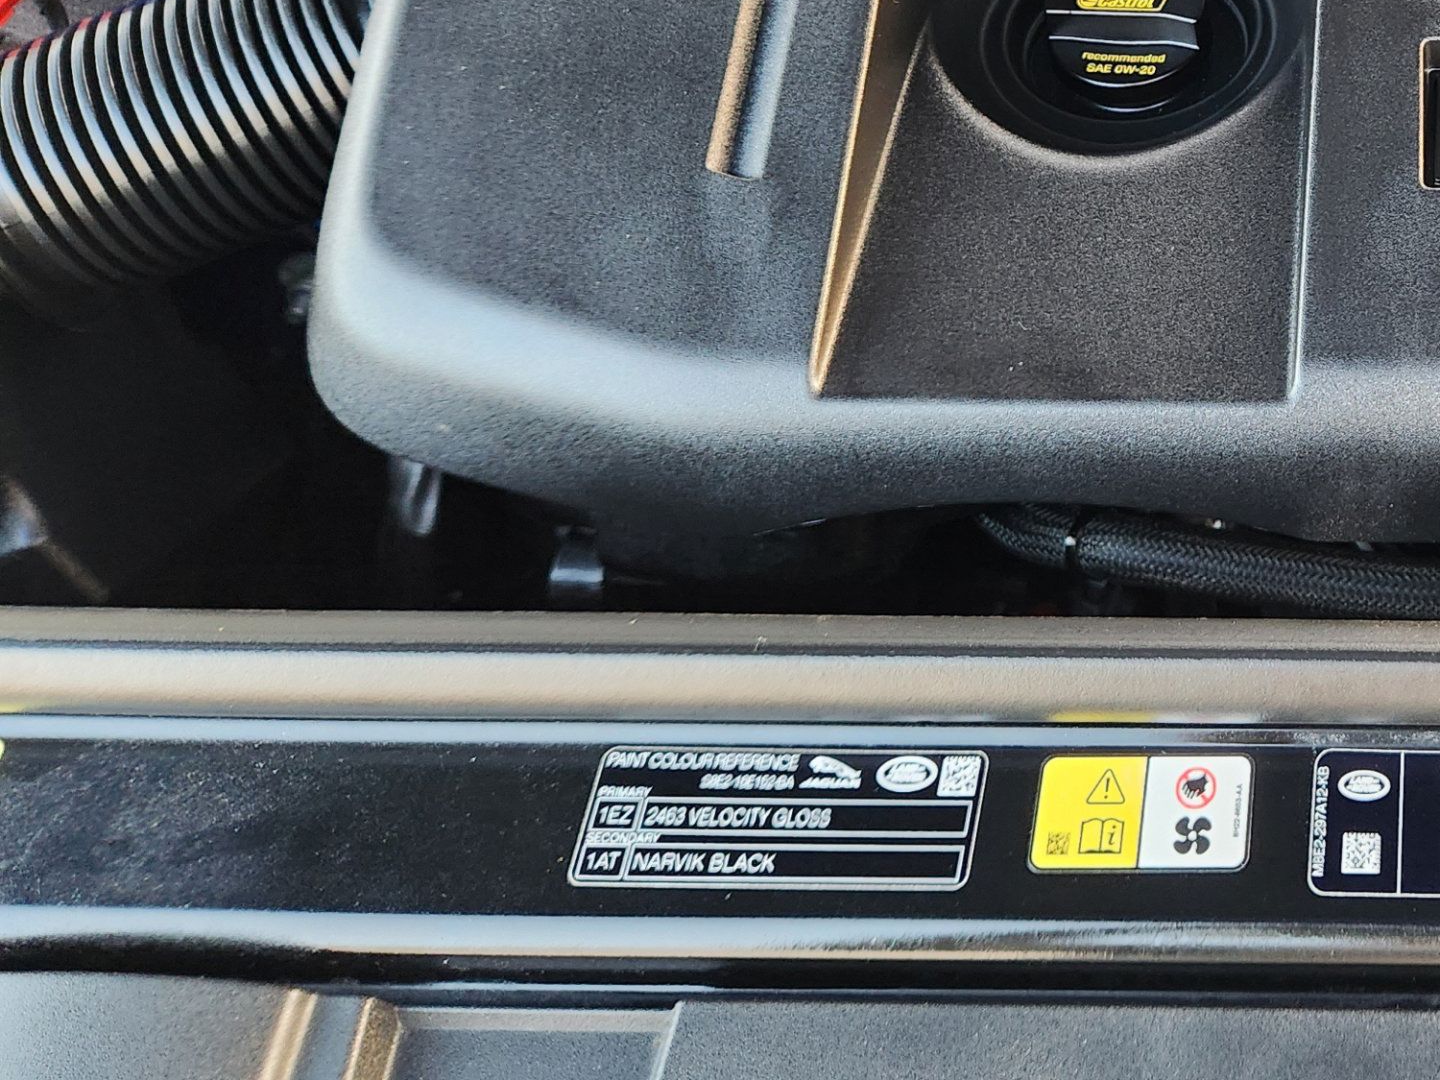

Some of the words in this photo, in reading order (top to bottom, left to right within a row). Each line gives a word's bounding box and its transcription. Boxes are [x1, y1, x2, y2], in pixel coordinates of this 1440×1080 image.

[1082, 51, 1166, 64] recommended
[1086, 63, 1112, 74] SAE
[1114, 64, 1157, 76] 0W-20
[605, 751, 651, 769] PAINT
[650, 751, 714, 770] COLOUR
[712, 752, 801, 772] REFERENCE
[597, 785, 653, 797] PRIMARY
[646, 806, 687, 827] 2463
[689, 806, 772, 828] VELOCITY
[771, 807, 833, 829] GLOSS
[584, 831, 662, 844] SECONDARY
[585, 851, 622, 871] 1AT
[631, 852, 706, 872] NARVIK
[707, 852, 777, 874] BLACK
